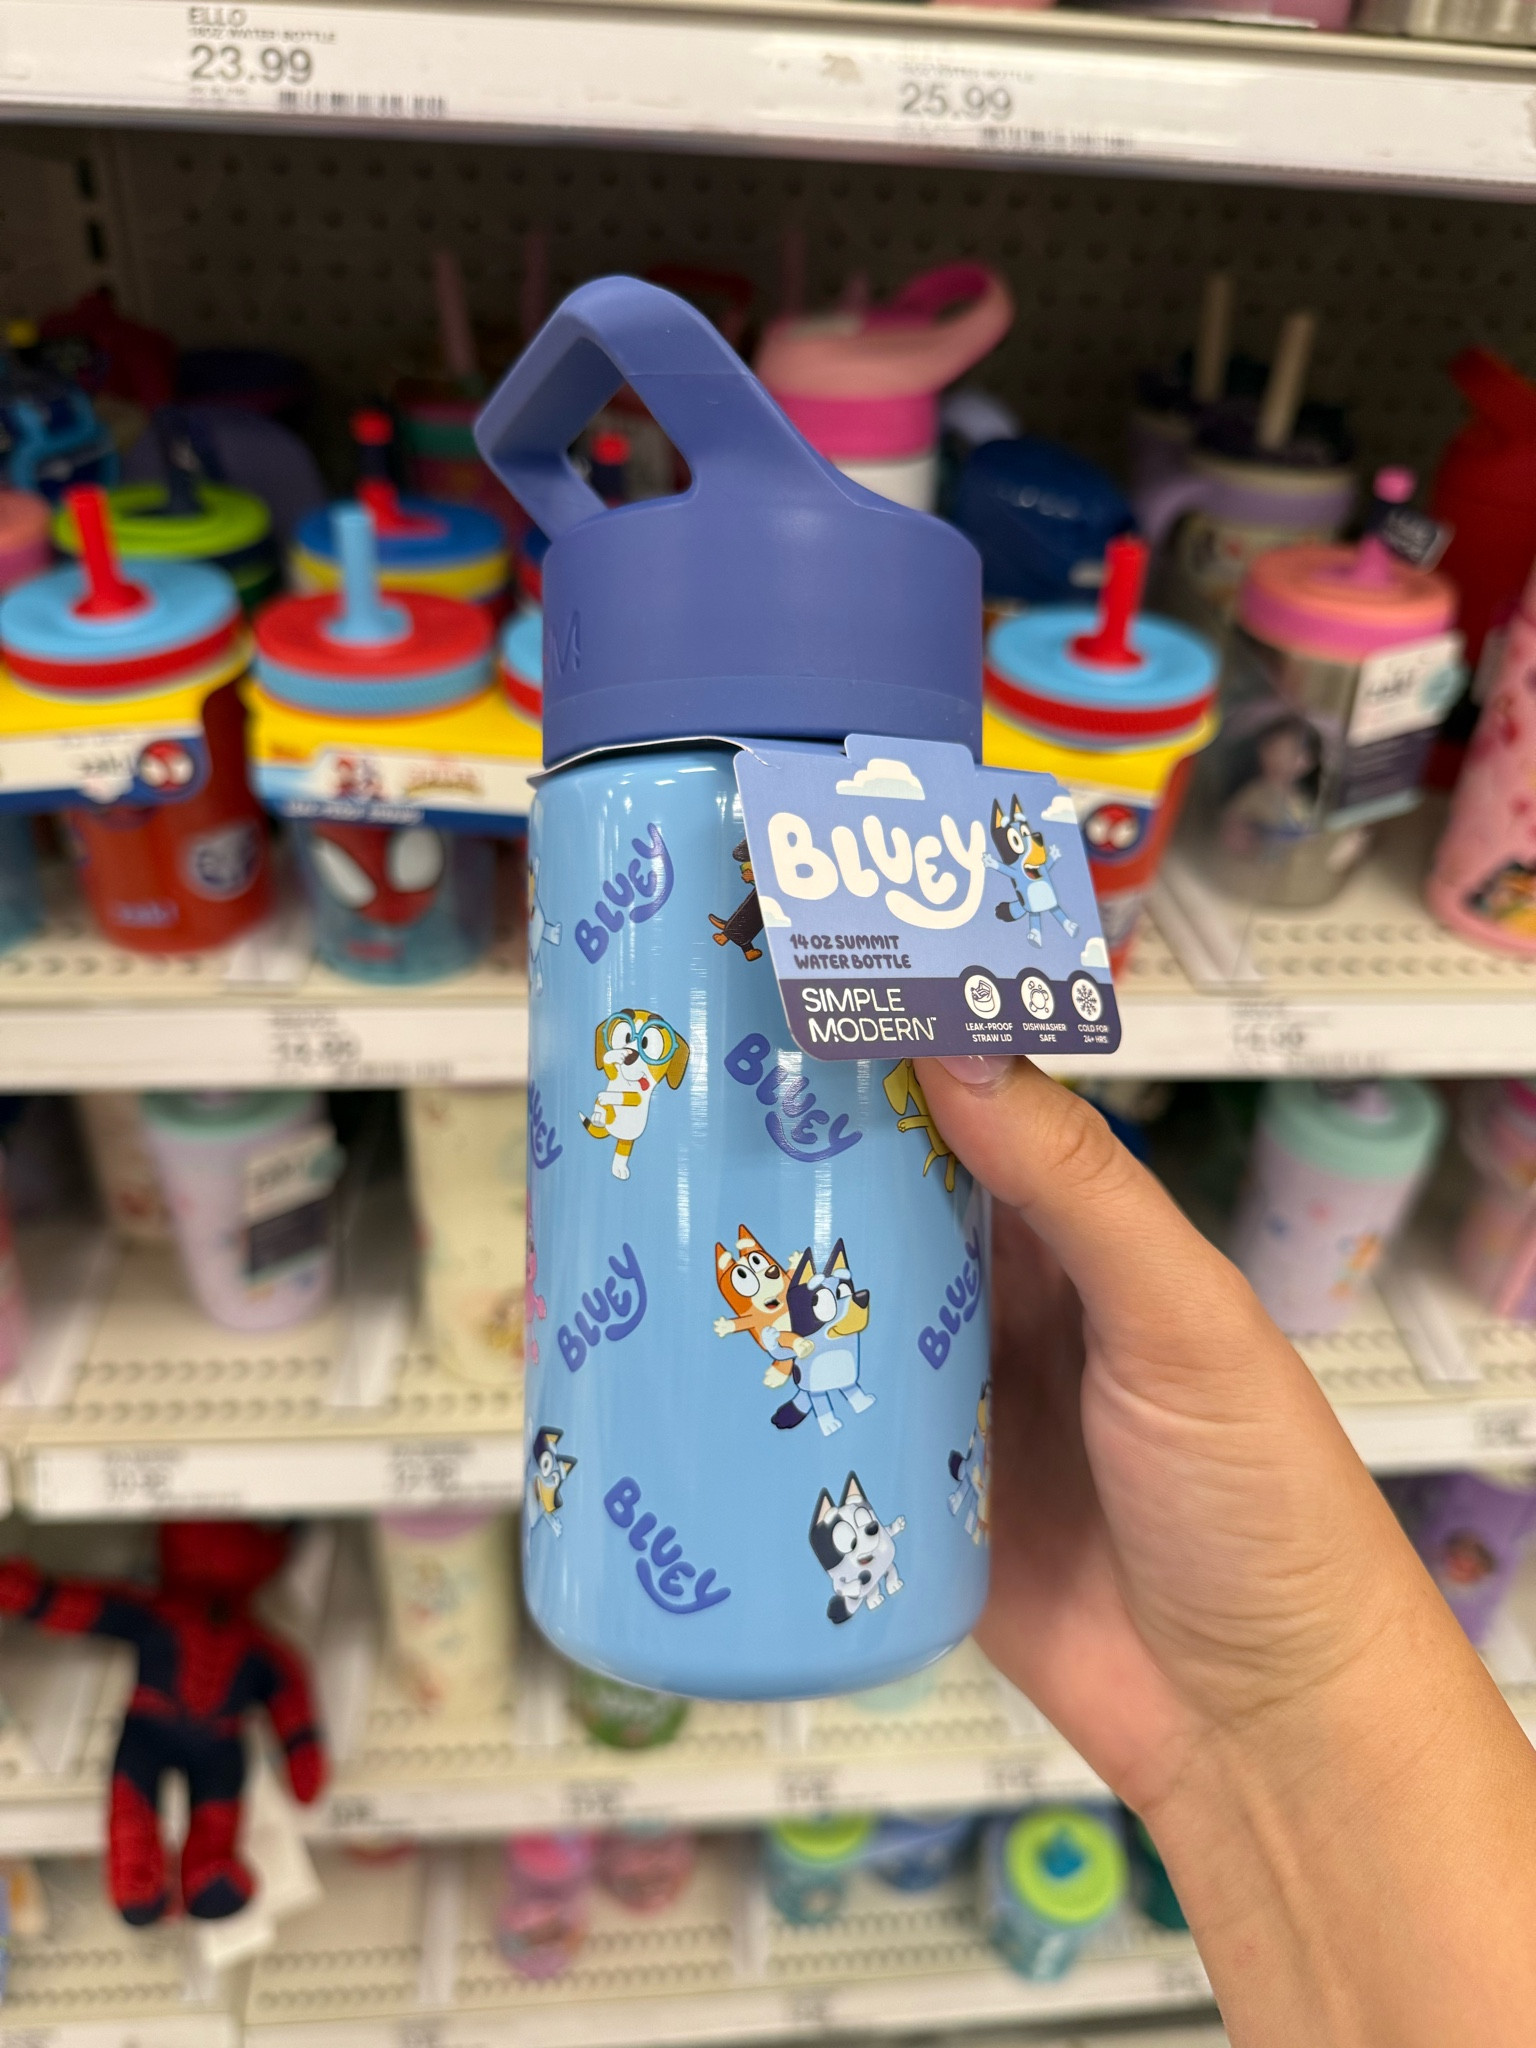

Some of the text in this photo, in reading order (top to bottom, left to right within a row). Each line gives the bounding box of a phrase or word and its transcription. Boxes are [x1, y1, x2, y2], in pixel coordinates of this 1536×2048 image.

[189, 7, 247, 27] ELLO
[191, 44, 313, 83] 23.99
[902, 82, 1013, 121] 25.99
[767, 812, 986, 929] BLUEY
[574, 822, 674, 964] BLUEY
[790, 933, 899, 950] 14 OZ SUMMIT
[794, 954, 912, 969] WATER BOTTLE
[801, 987, 905, 1012] SIMPLE
[965, 1022, 1013, 1031] LEAK-PROOF
[972, 1033, 1013, 1042] STRAW LID
[1022, 1023, 1067, 1032] DISHWASHER
[1077, 1024, 1109, 1034] COLD FOR
[1039, 1034, 1056, 1042] SAFE
[1095, 1035, 1109, 1044] HRS
[723, 1033, 863, 1162] BLUEY
[557, 1242, 647, 1372] BLUEY
[918, 1226, 982, 1370] BLUEY
[603, 1476, 732, 1614] BLUEY
